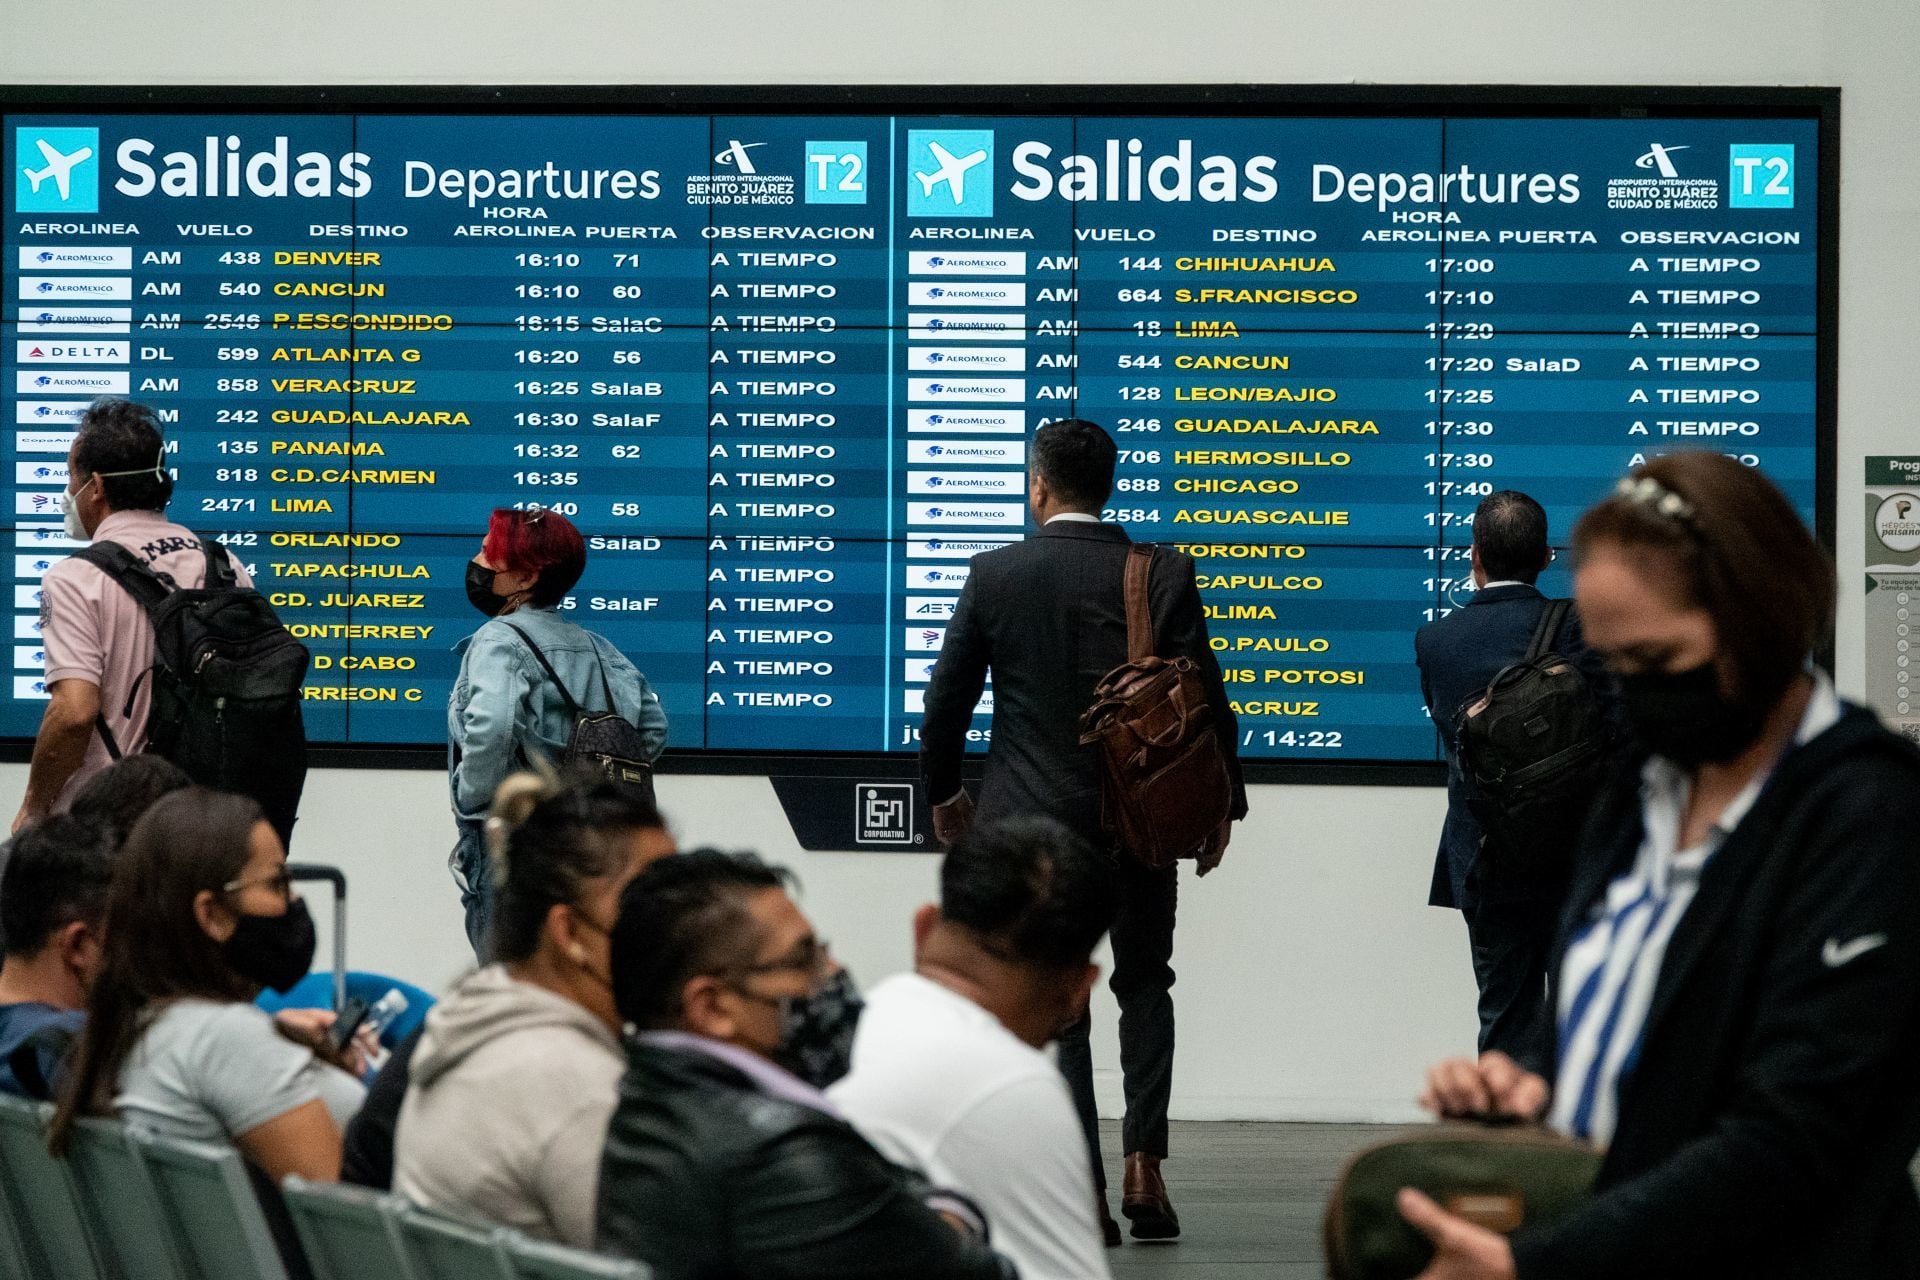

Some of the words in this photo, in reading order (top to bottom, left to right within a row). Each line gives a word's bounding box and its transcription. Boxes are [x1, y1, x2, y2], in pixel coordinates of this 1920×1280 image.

[115, 136, 371, 197] Salidas
[405, 160, 661, 207] Departures
[810, 154, 862, 190] T2
[1011, 139, 1277, 202] Salidas
[1312, 164, 1580, 212] Departures
[1735, 158, 1788, 194] T2
[687, 183, 738, 194] BENITO
[741, 182, 794, 194] JUÁREZ
[1608, 187, 1660, 198] BENITO
[1663, 185, 1717, 198] JUÁREZ
[687, 196, 731, 204] CIUDAD
[734, 196, 749, 204] DE
[752, 194, 794, 204] MÉXICO
[1608, 200, 1652, 208] CIUDAD
[1656, 200, 1671, 208] DE
[1674, 199, 1717, 208] MÉXICO
[483, 206, 548, 219] HORA
[1392, 211, 1462, 224] HORA
[19, 223, 140, 235] AEROLINEA
[176, 224, 253, 236] VUELO
[309, 224, 409, 237] DESTINO
[453, 225, 577, 237] AEROLINEA
[586, 226, 678, 239] PUERTA
[701, 226, 875, 240] OBSERVACION
[909, 227, 1035, 239] AEROLINEA
[1074, 228, 1156, 241] VUELO
[1212, 229, 1317, 242] DESTINO
[1361, 230, 1491, 242] AEROLINEA
[1499, 230, 1597, 244] PUERTA
[1620, 231, 1800, 245] OBSERVACION
[142, 251, 181, 265] AM
[218, 251, 261, 265] 438
[274, 251, 381, 266] DENVER
[515, 253, 580, 267] 16:10
[613, 254, 639, 268] 71
[710, 252, 730, 266] A
[737, 252, 837, 267] TIEMPO
[1036, 256, 1079, 270] AM
[1119, 257, 1162, 271] 144
[1175, 257, 1336, 272] CHIHUAHUA
[1425, 258, 1494, 273] 17:00
[1629, 257, 1650, 272] A
[1657, 258, 1761, 272] TIEMPO
[141, 282, 181, 296] AM
[219, 282, 261, 296] 540
[273, 282, 385, 297] CANCUN
[515, 284, 580, 298] 16:10
[613, 285, 641, 299] 60
[1036, 288, 1078, 302] AM
[1117, 288, 1162, 303] 664
[1175, 289, 1358, 304] S.FRANCISCO
[1425, 290, 1494, 305] 17:10
[273, 313, 453, 331] P.ESCONDIDO
[1175, 320, 1240, 338] LIMA
[51, 347, 119, 357] DELTA
[141, 347, 174, 360] DL
[217, 347, 259, 361] 599
[271, 348, 395, 362] ATLANTA
[401, 349, 421, 362] G
[514, 350, 579, 364] 16:20
[613, 351, 641, 364] 56
[710, 350, 729, 363] A
[736, 350, 836, 364] TIEMPO
[1036, 354, 1078, 368] AM
[1118, 355, 1162, 369] 544
[1175, 355, 1289, 370] CANCUN
[1425, 357, 1494, 372] 17:20
[1506, 358, 1581, 372] SalaD
[1628, 356, 1649, 371] A
[1656, 357, 1760, 372] TIEMPO
[139, 378, 179, 391] AM
[217, 378, 259, 392] 858
[271, 379, 416, 394] VERACRUZ
[514, 381, 579, 395] 16:25
[591, 382, 662, 396] SalaB
[1035, 385, 1078, 400] AM
[1118, 386, 1161, 401] 128
[1175, 387, 1337, 402] LEON/BAJIO
[1424, 389, 1494, 404] 17:25
[216, 409, 259, 423] 242
[271, 410, 471, 425] GUADALAJARA
[514, 412, 579, 426] 16:30
[592, 413, 661, 427] SalaF
[709, 412, 729, 426] A
[736, 413, 836, 427] TIEMPO
[1117, 418, 1161, 432] 246
[1174, 419, 1380, 434] GUADALAJARA
[1424, 421, 1493, 436] 17:30
[1628, 421, 1649, 435] A
[1656, 421, 1760, 436] TIEMPO
[217, 440, 259, 454] 135
[271, 441, 385, 456] PANAMA
[513, 444, 579, 458] 16:32
[611, 445, 640, 458] 62
[1117, 450, 1161, 464] 706
[1174, 450, 1351, 466] HERMOSILLO
[1424, 453, 1493, 468] 17:30
[216, 468, 258, 482] 818
[271, 469, 435, 484] C.D.CARMEN
[513, 471, 578, 486] 16:35
[709, 472, 729, 486] A
[735, 473, 835, 487] TIEMPO
[1117, 478, 1161, 492] 688
[1174, 479, 1299, 494] CHICAGO
[1424, 481, 1493, 496] 17:40
[201, 498, 255, 512] 2471
[271, 498, 333, 513] LIMA
[611, 503, 640, 516] 58
[1101, 508, 1161, 523] 2584
[1173, 509, 1349, 525] AGUASCALIE
[215, 531, 258, 546] 442
[270, 532, 401, 547] ORLANDO
[1173, 543, 1306, 559] TORONTO
[270, 563, 430, 579] TAPACHULA
[708, 568, 727, 582] A
[734, 568, 834, 583] TIEMPO
[1195, 575, 1323, 590] CAPULCO
[269, 593, 312, 607] CD.
[319, 593, 425, 608] JUAREZ
[590, 597, 659, 611] SalaF
[707, 597, 727, 611] A
[734, 598, 834, 613] TIEMPO
[282, 624, 434, 639] ONTERREY
[314, 655, 332, 669] D
[339, 656, 416, 670] CABO
[706, 660, 726, 674] A
[733, 661, 833, 676] TIEMPO
[1264, 669, 1364, 685] POTOSI
[404, 688, 422, 702] C
[1263, 730, 1342, 747] 14:22
[863, 830, 905, 838] CORPORATIVO
